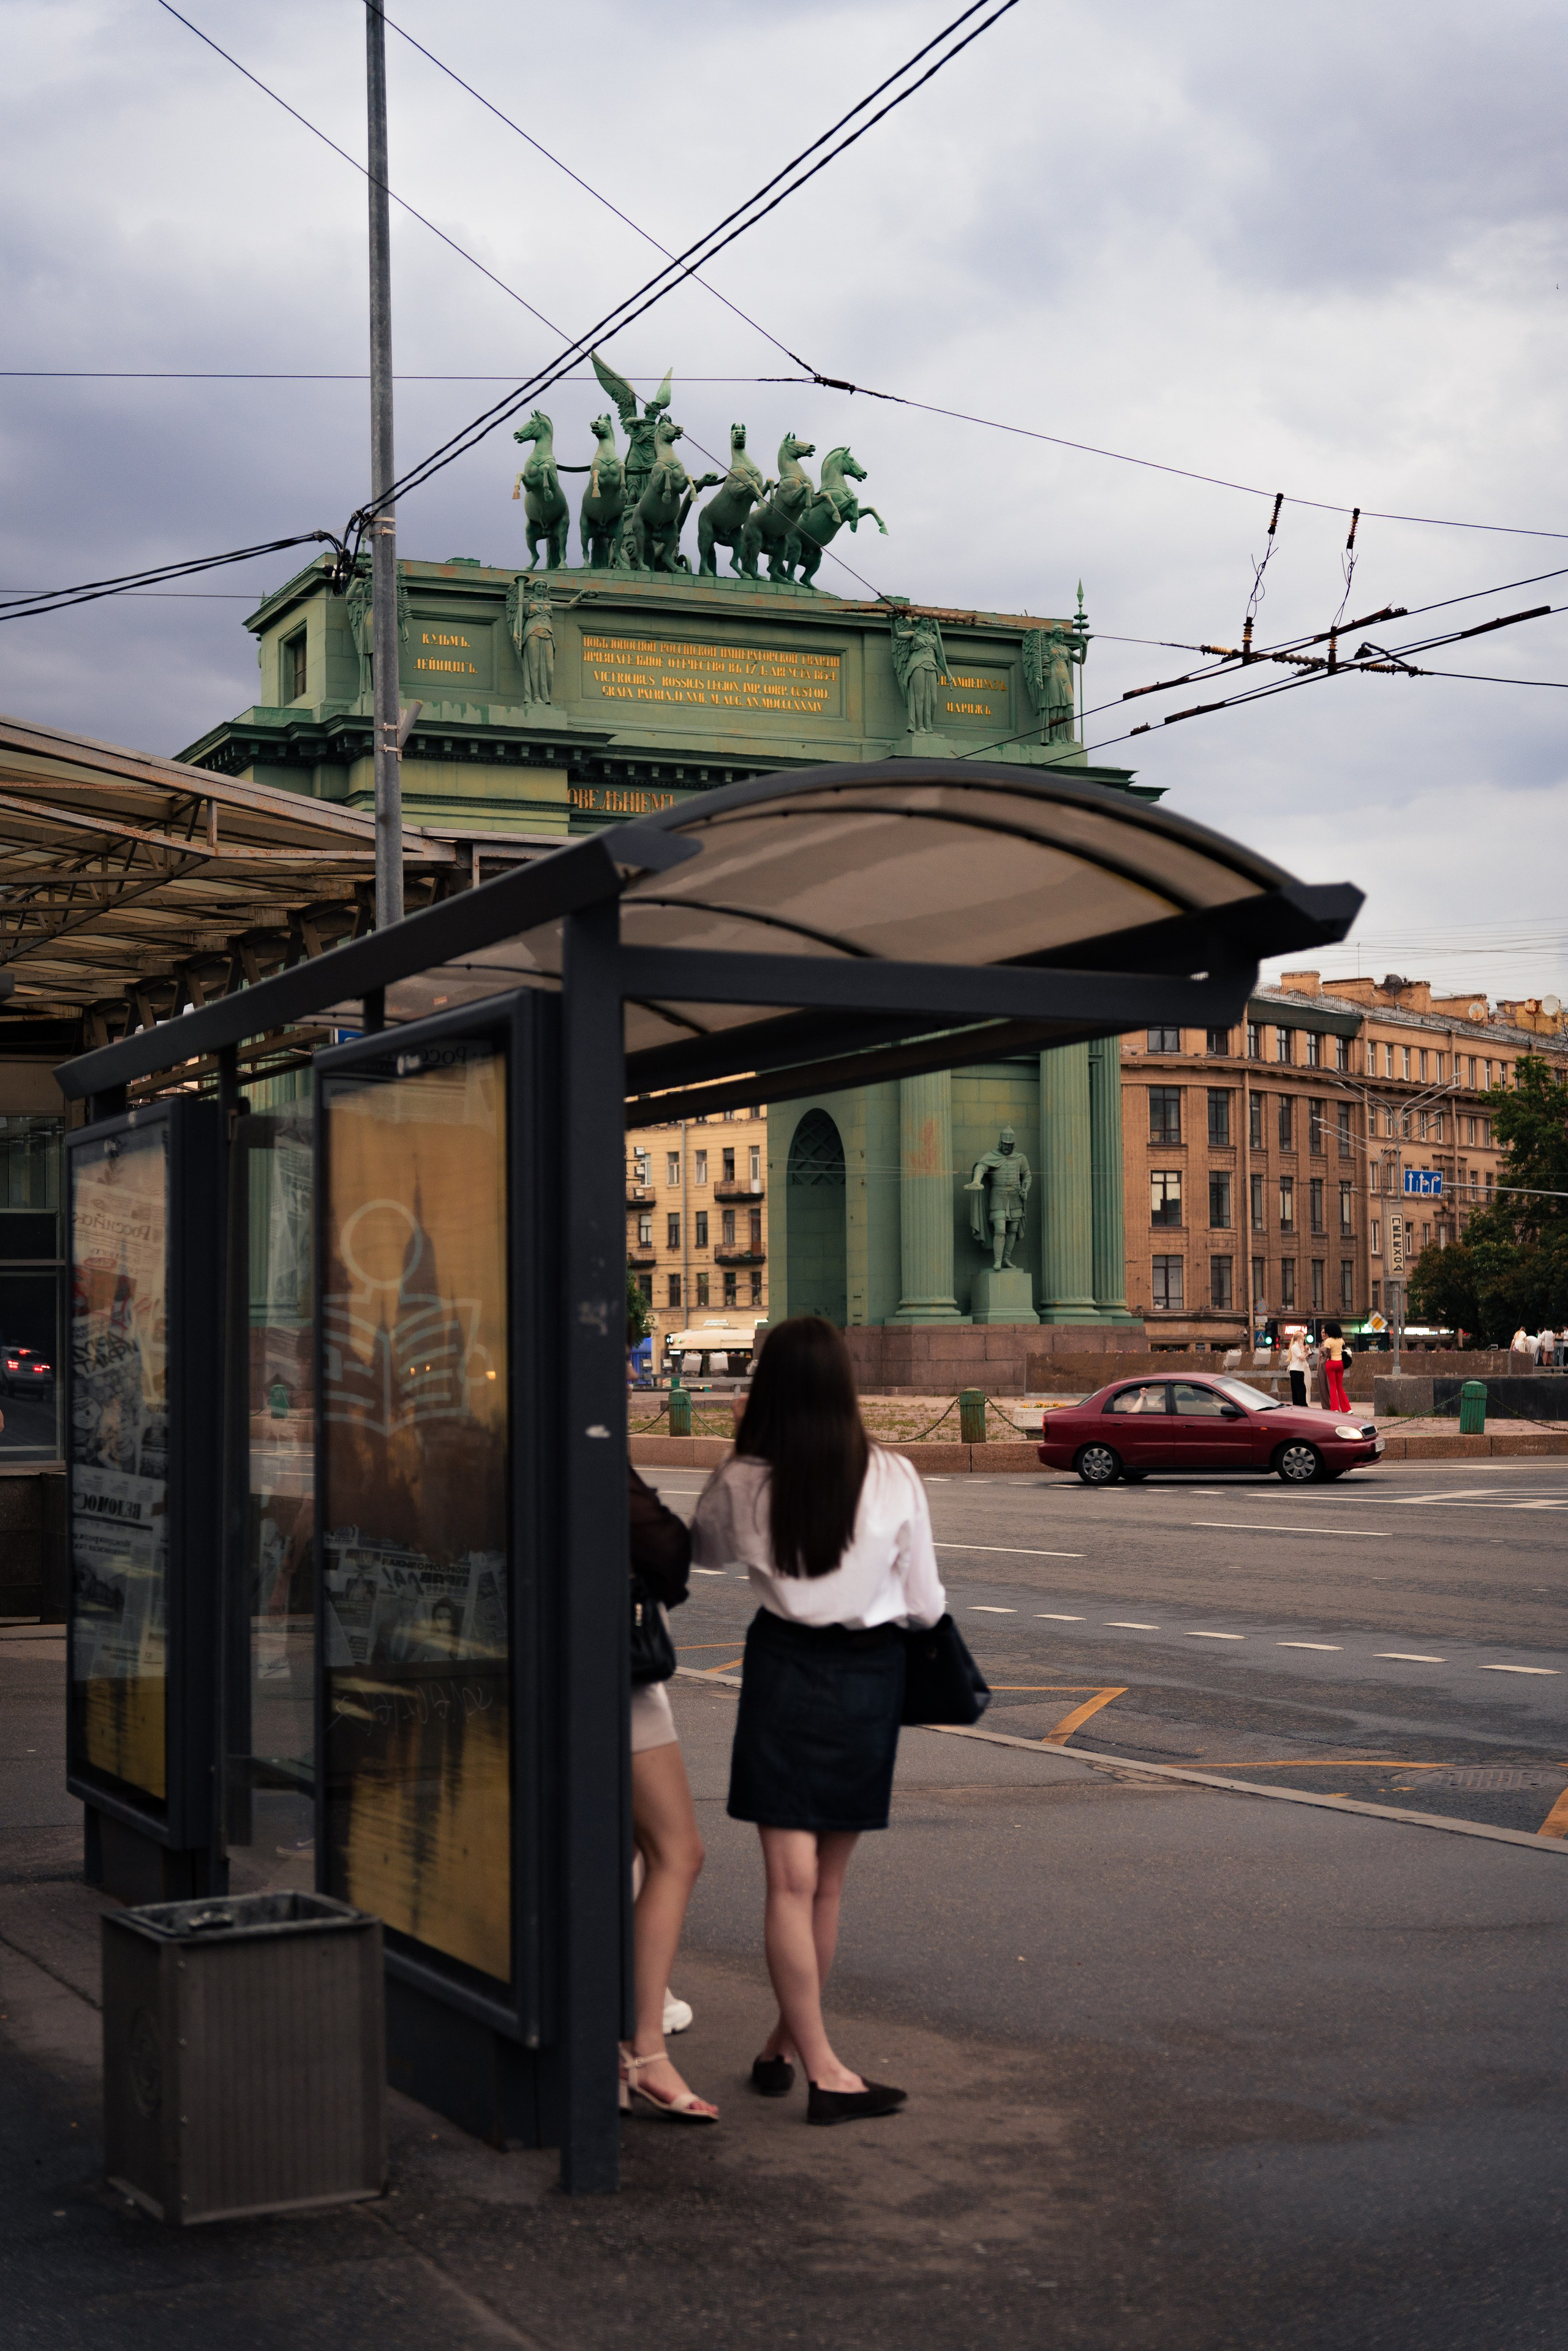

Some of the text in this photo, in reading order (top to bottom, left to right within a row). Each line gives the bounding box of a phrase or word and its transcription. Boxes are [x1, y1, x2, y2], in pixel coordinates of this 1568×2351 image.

[668, 657, 725, 673] ОТЕЧЕСТВО
[728, 662, 742, 674] ВЪ
[745, 663, 756, 674] 17
[771, 666, 811, 680] АВГУСТА
[594, 670, 830, 700] VICTRICIBUS ROSSICIS LEGION. IMP. CORP. CUSTOD.
[602, 685, 633, 698] GRATA
[1392, 1217, 1403, 1271] ПЕРЕХОД
